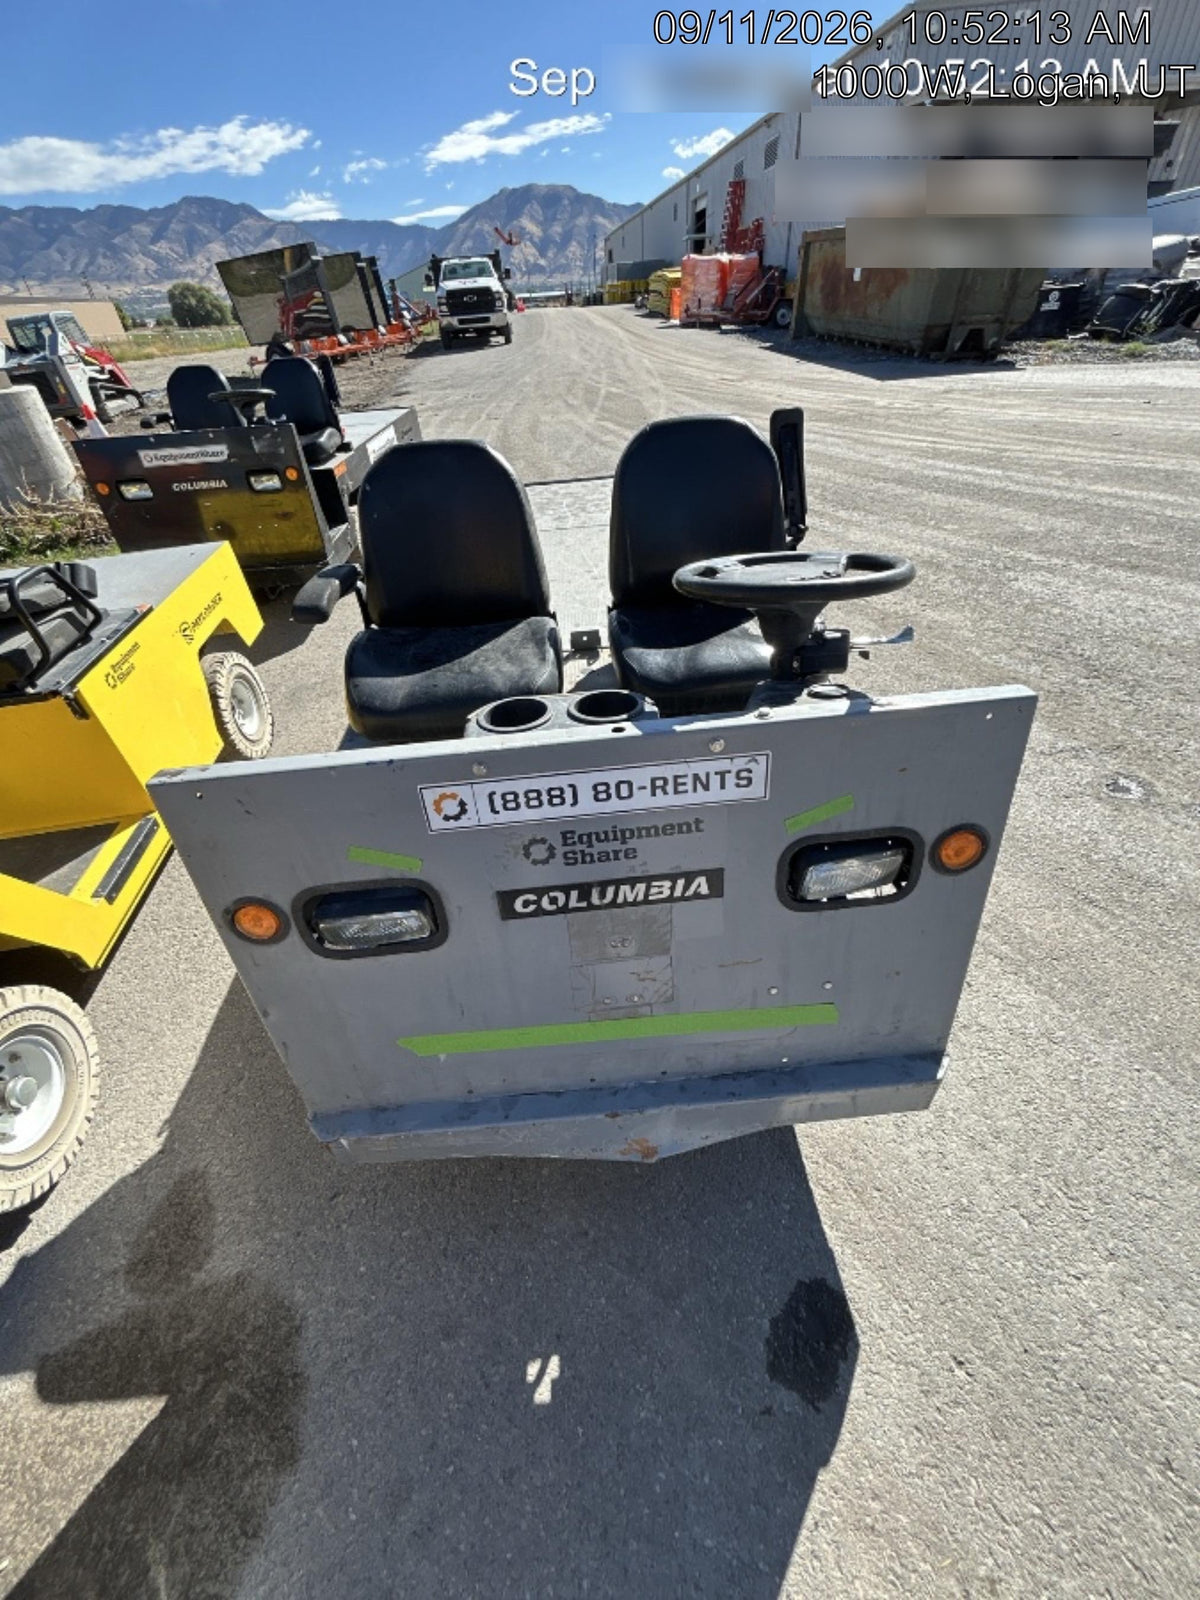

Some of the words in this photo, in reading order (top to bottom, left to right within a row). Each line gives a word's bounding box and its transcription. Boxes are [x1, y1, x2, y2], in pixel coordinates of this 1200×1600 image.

[487, 783, 580, 815] (888)
[591, 767, 755, 802] 80-RENTS
[560, 817, 705, 849] Equipment
[562, 847, 639, 867] Share
[513, 876, 711, 913] COLUMBIA
